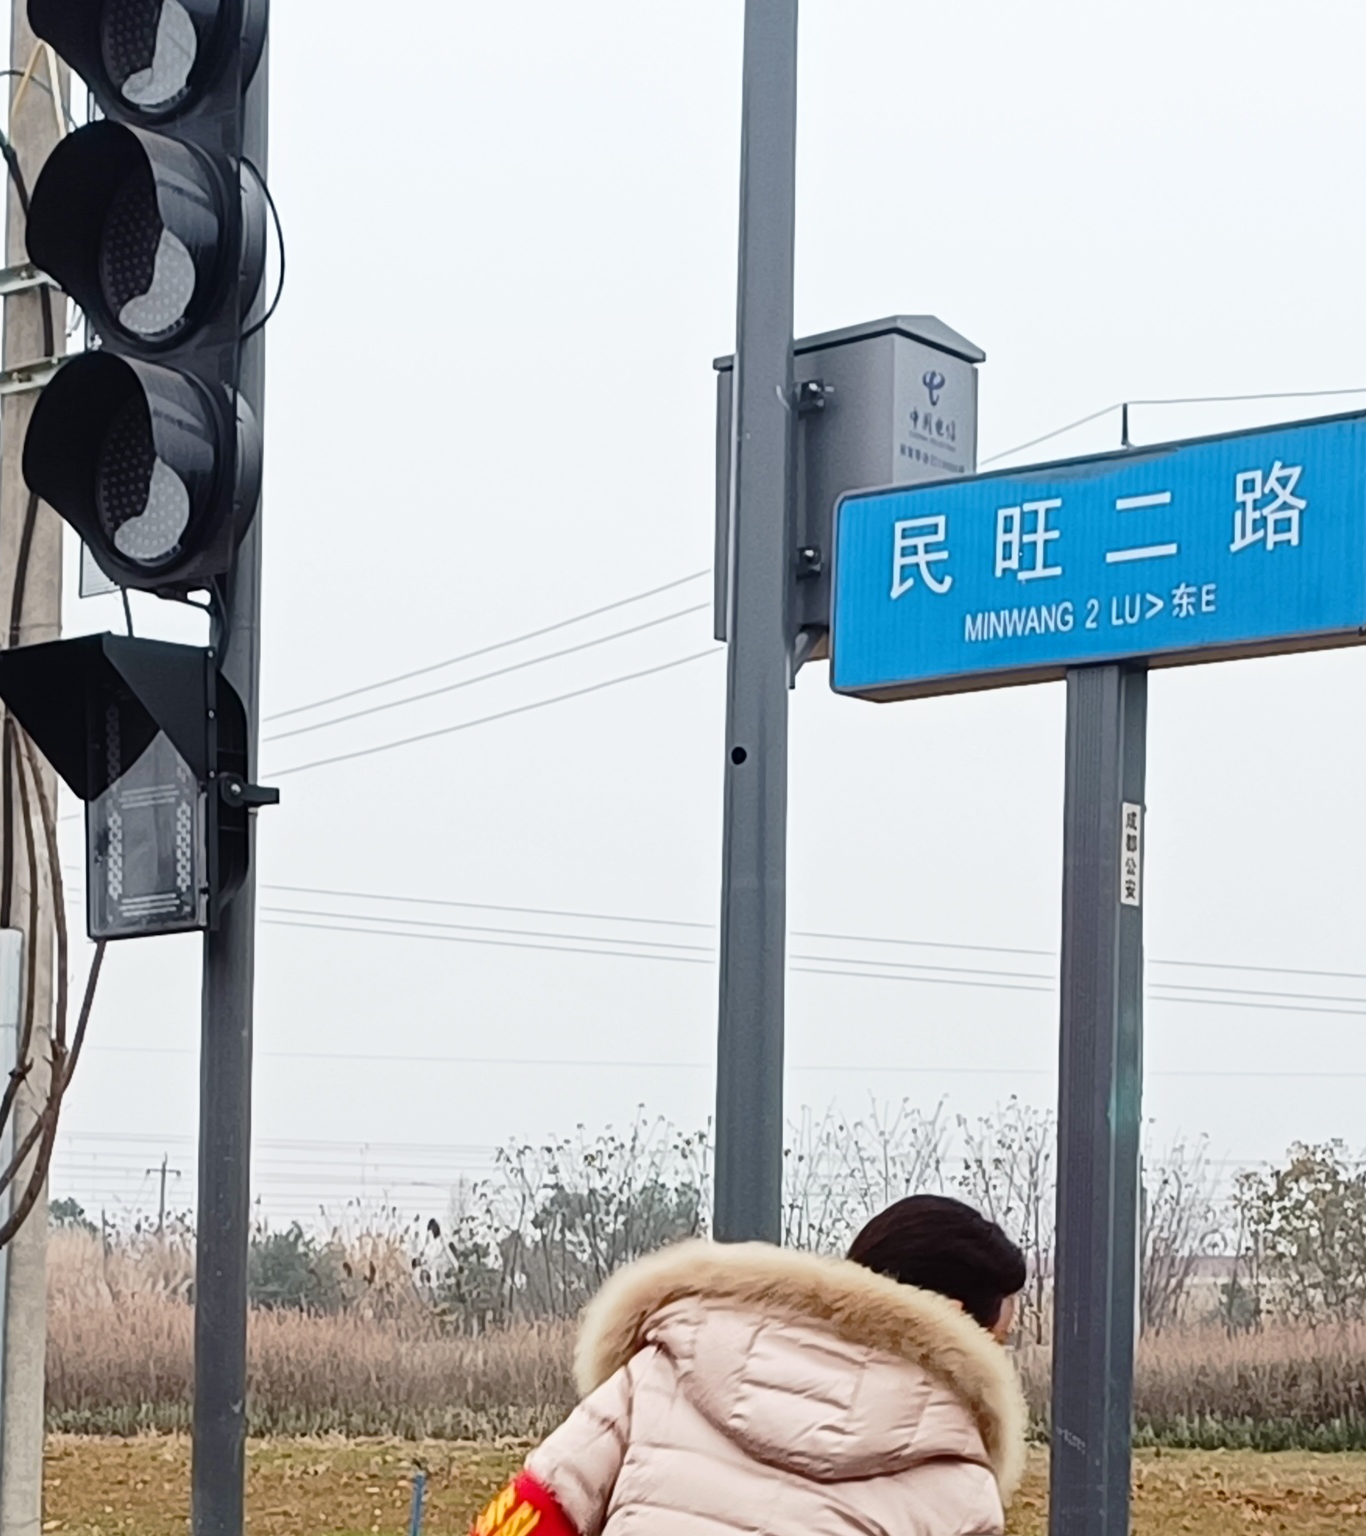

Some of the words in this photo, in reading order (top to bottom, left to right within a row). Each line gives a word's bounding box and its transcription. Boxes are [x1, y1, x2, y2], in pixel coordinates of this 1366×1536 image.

[890, 460, 1307, 599] 民旺二路
[964, 602, 1073, 642] MINWANG
[1086, 599, 1098, 629] 2
